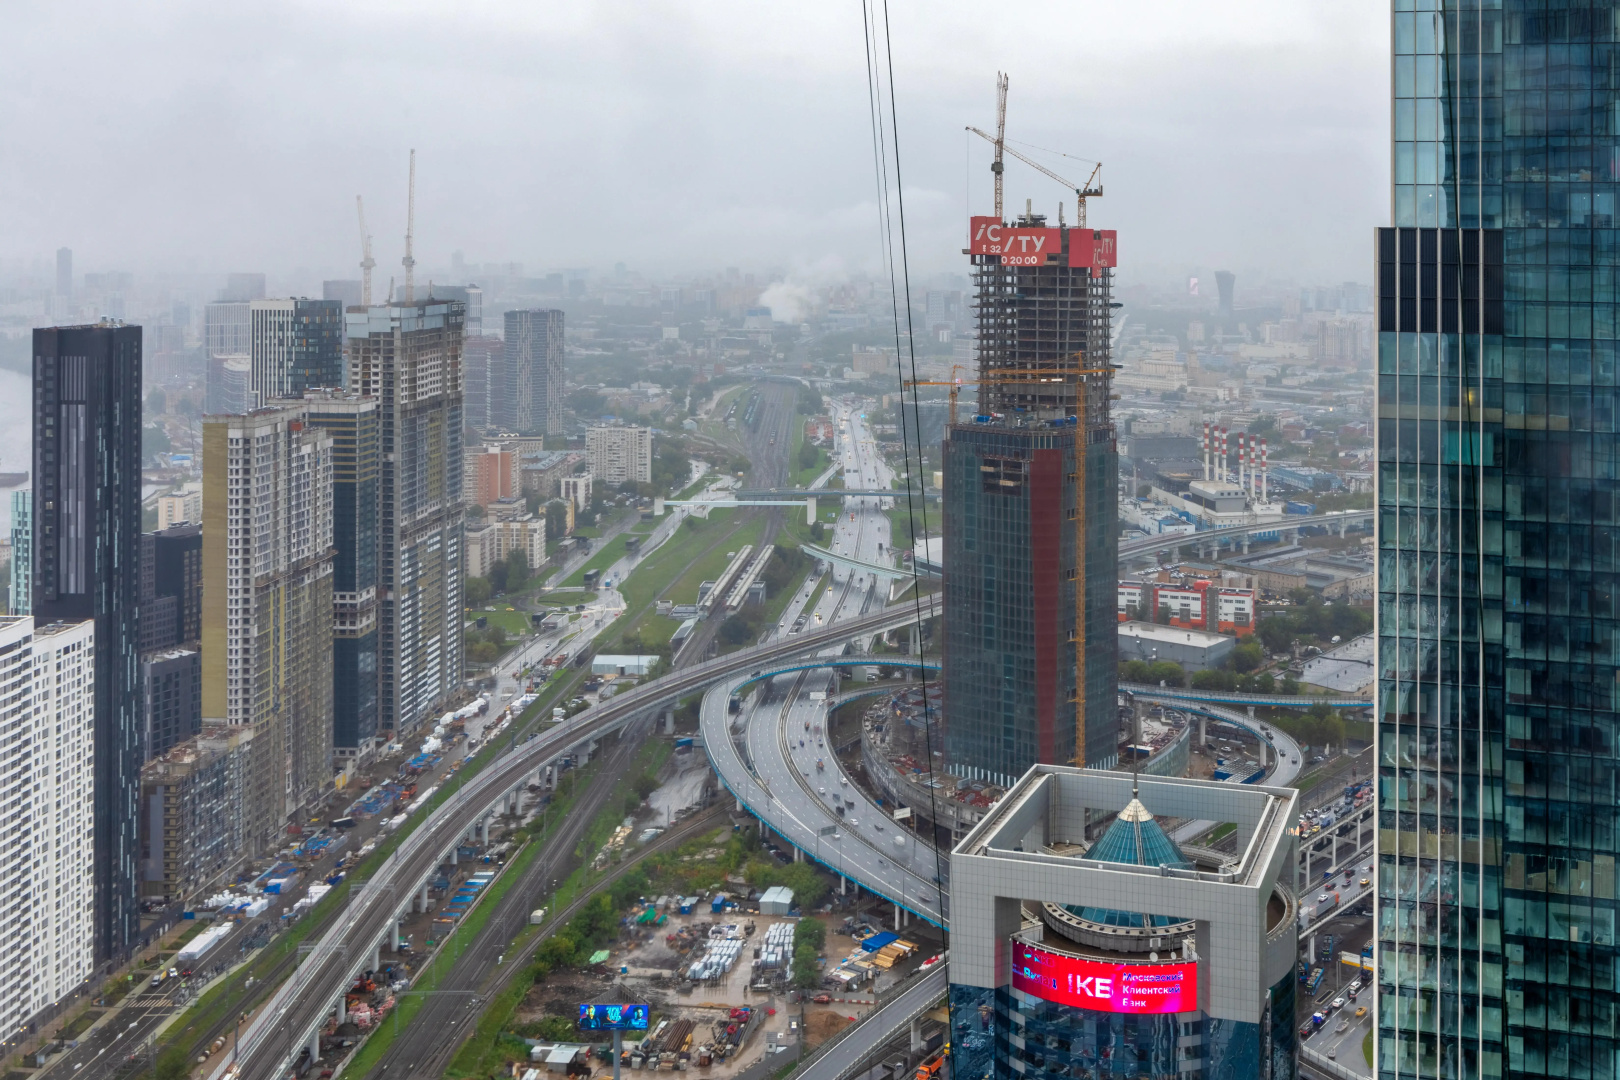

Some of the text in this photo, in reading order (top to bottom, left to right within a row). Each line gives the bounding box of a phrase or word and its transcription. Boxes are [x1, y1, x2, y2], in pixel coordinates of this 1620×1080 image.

[1010, 256, 1022, 264] 20
[1024, 256, 1037, 264] 00
[1122, 971, 1184, 982] Московский
[1122, 984, 1181, 994] Клиентский
